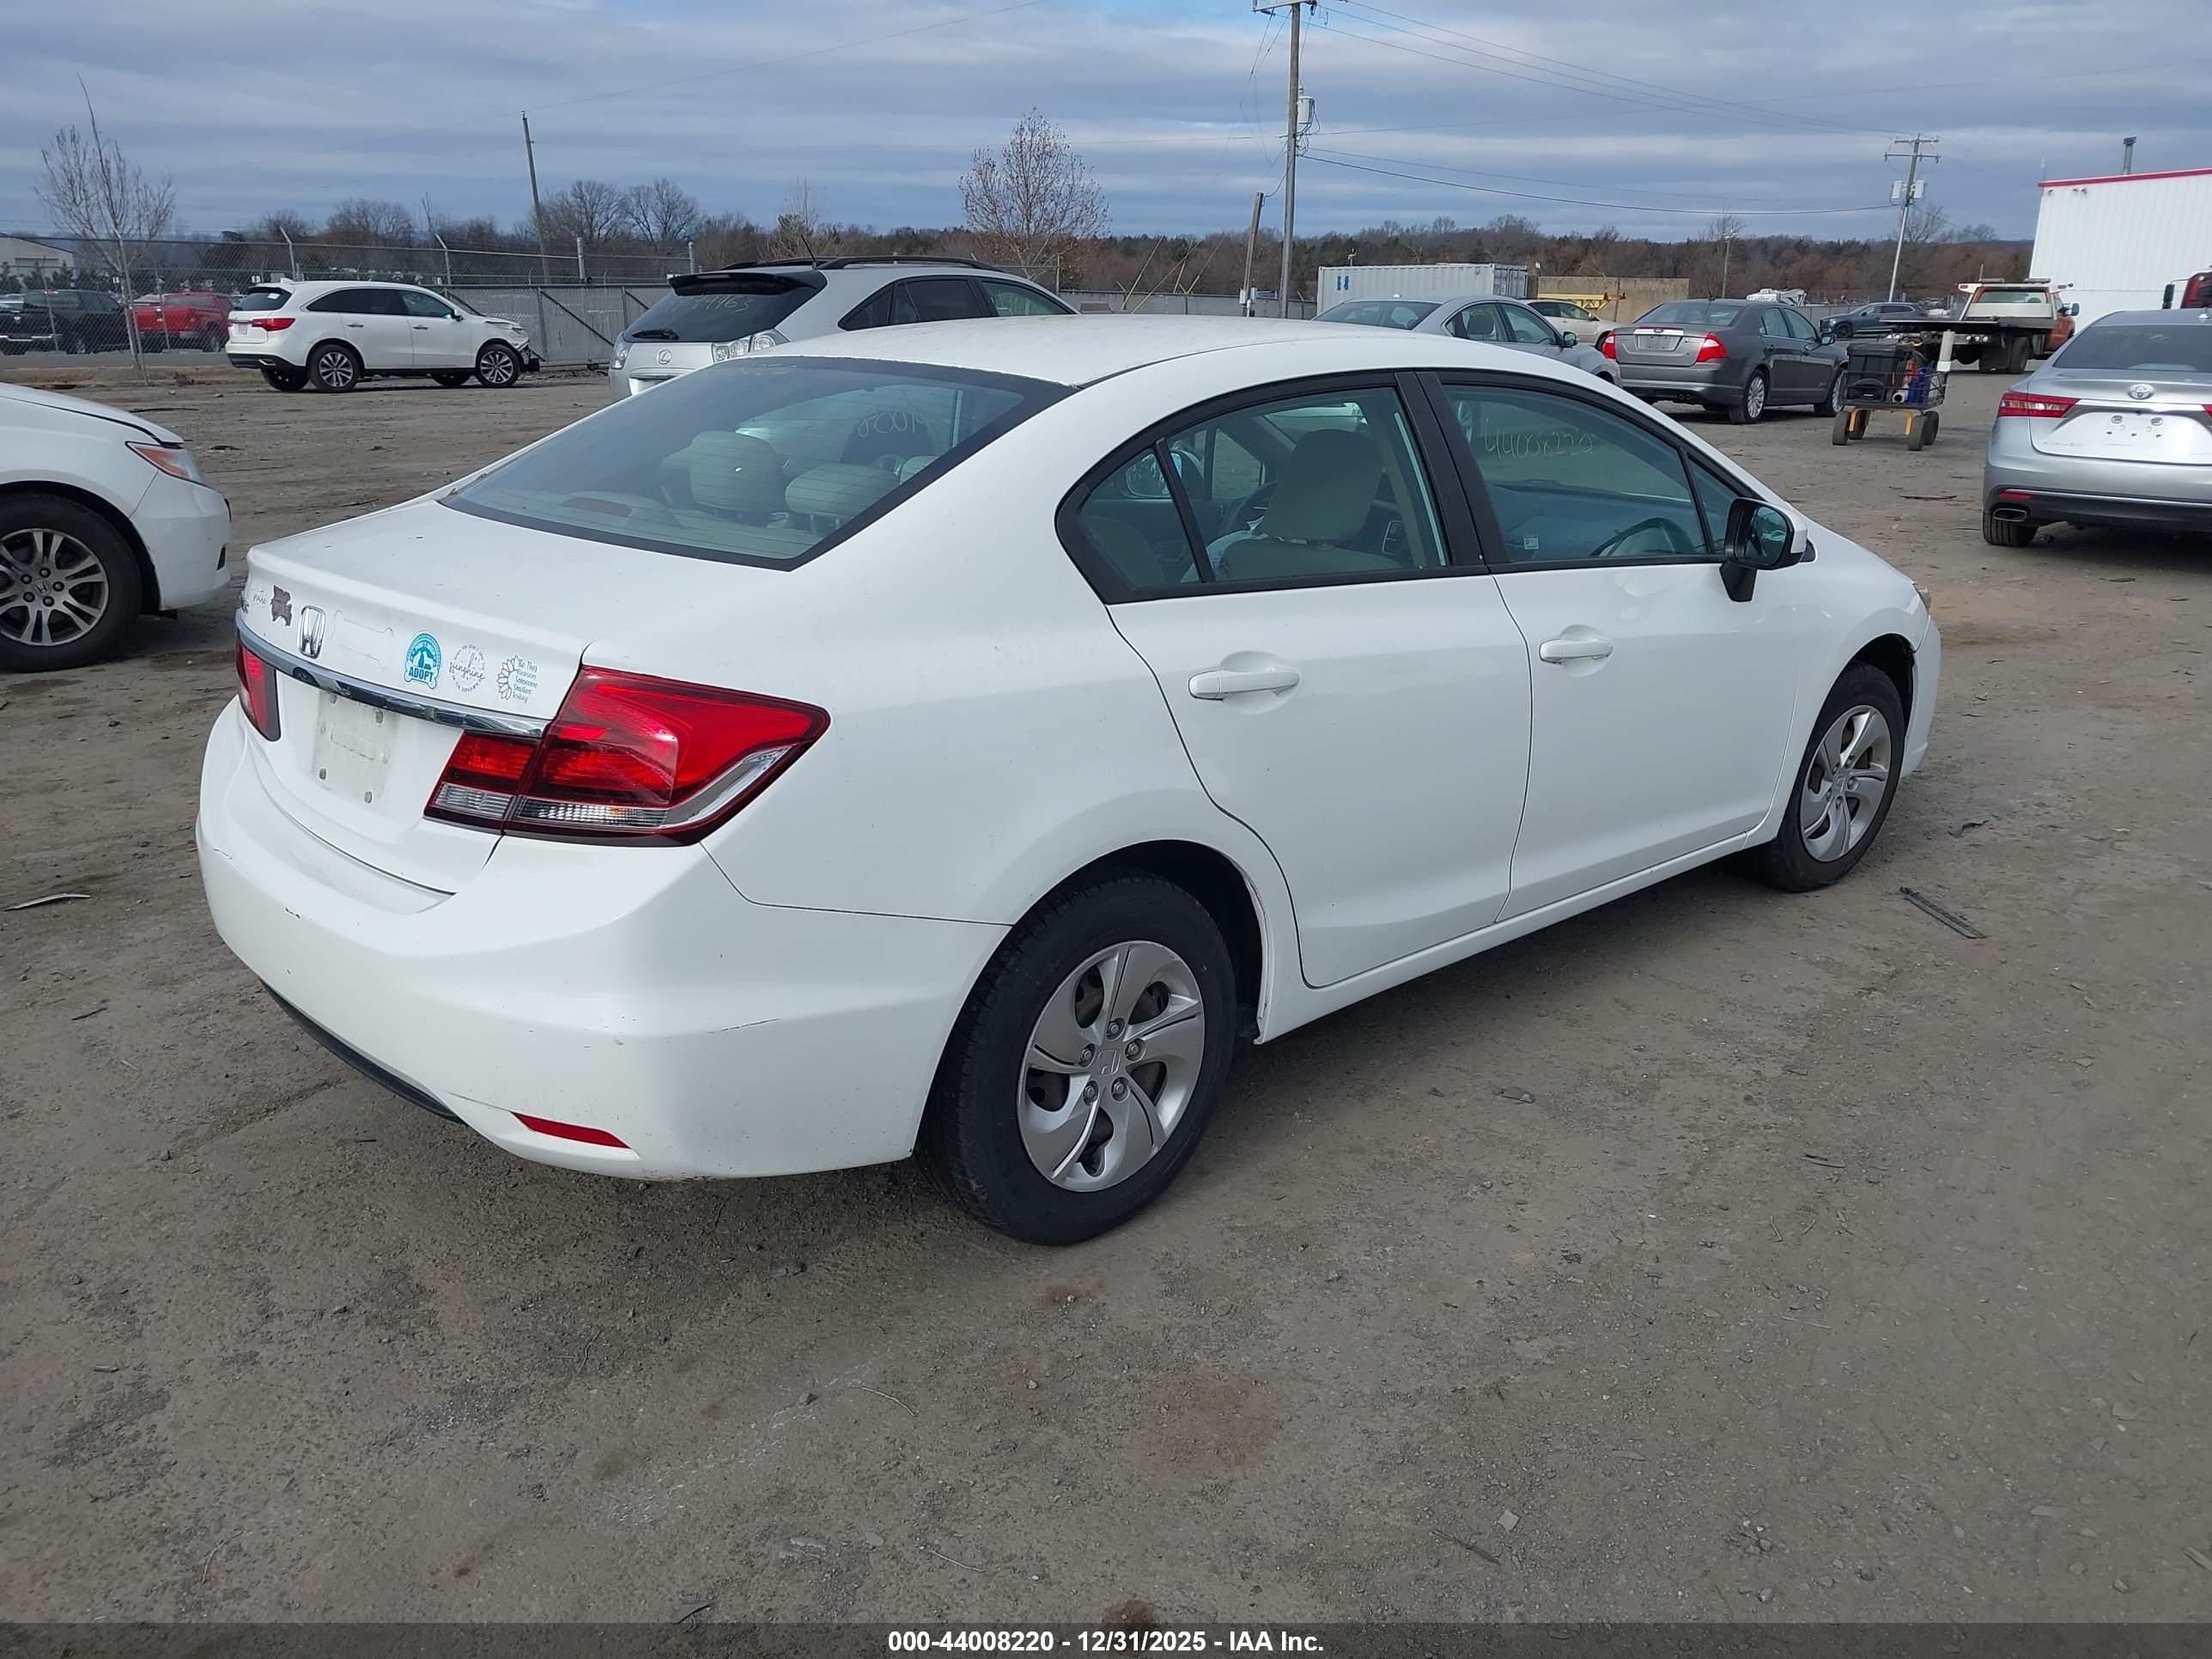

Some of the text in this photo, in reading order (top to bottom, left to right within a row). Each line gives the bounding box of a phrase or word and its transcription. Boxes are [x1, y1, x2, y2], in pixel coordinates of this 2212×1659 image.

[409, 665, 434, 682] ADOPT
[515, 675, 538, 688] Someone
[514, 683, 532, 695] Smiles
[513, 690, 528, 704] Today
